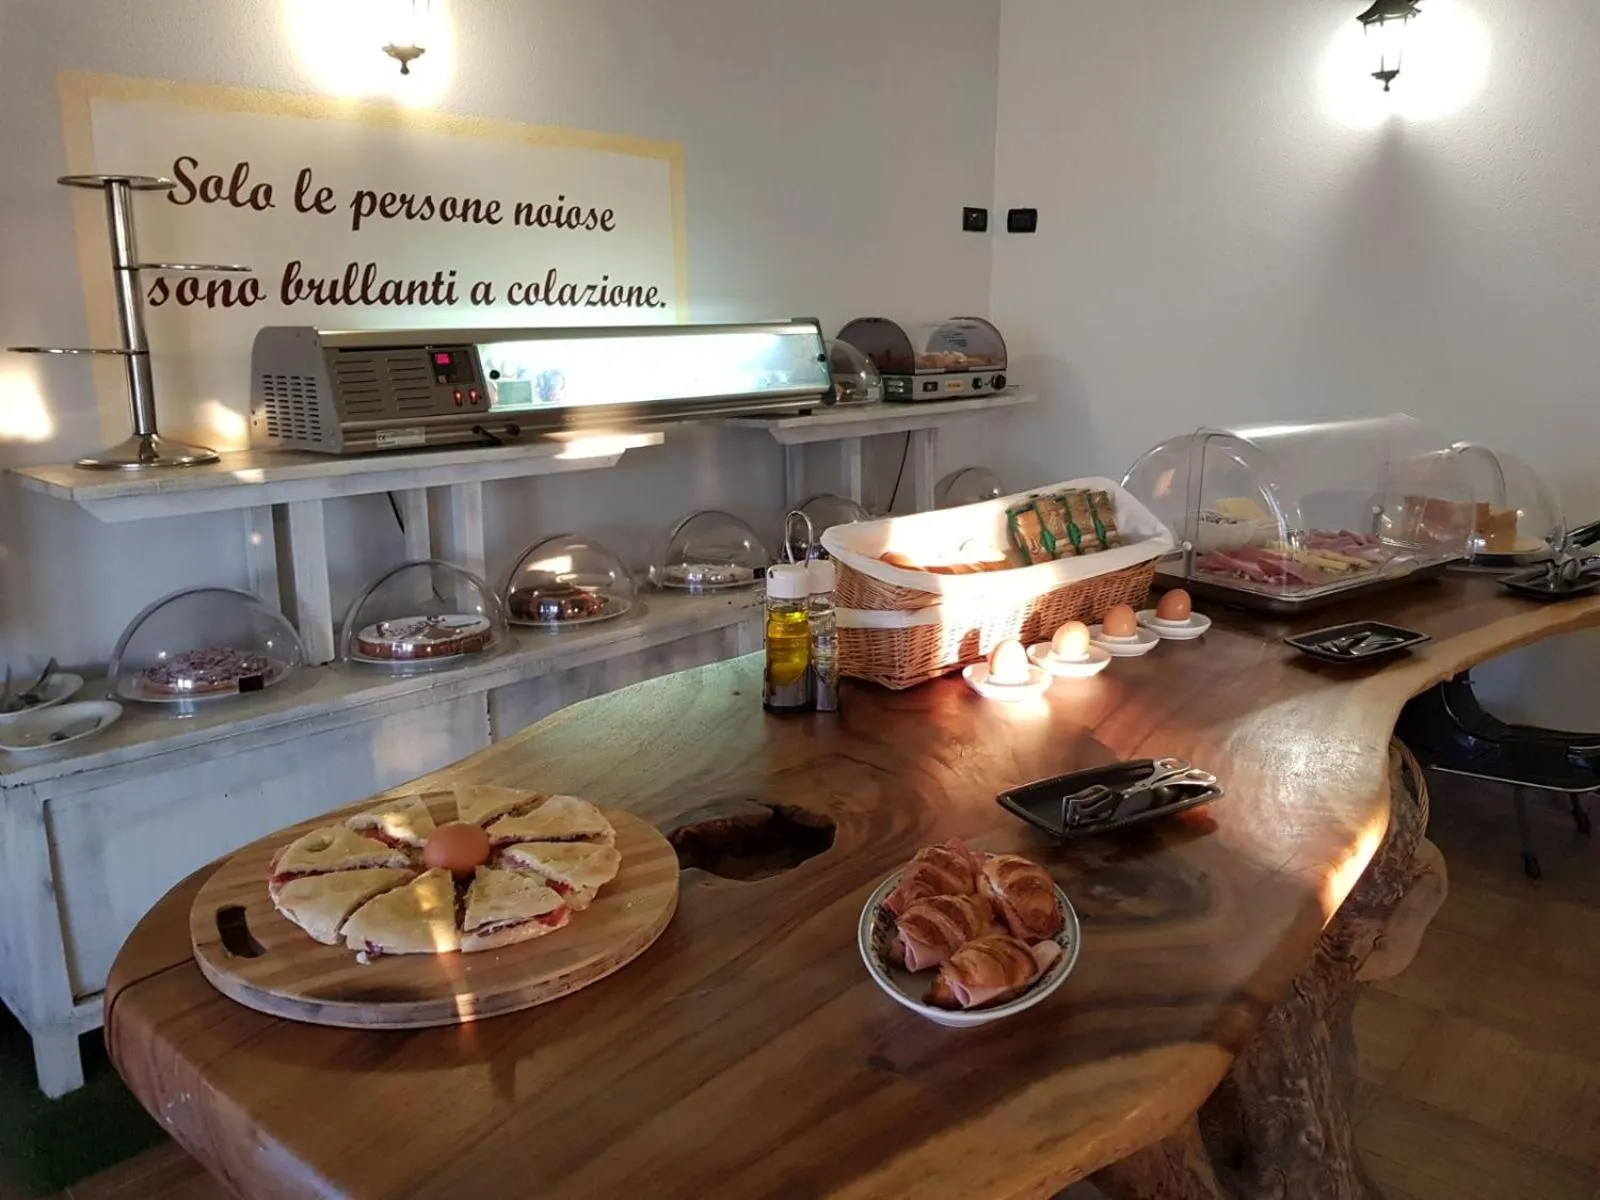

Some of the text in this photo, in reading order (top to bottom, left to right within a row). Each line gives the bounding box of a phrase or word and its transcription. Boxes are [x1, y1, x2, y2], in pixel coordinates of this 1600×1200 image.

[167, 156, 616, 232] Solo le persone noiose
[148, 275, 267, 309] sono
[471, 281, 497, 306] a
[507, 268, 667, 309] colazione.
